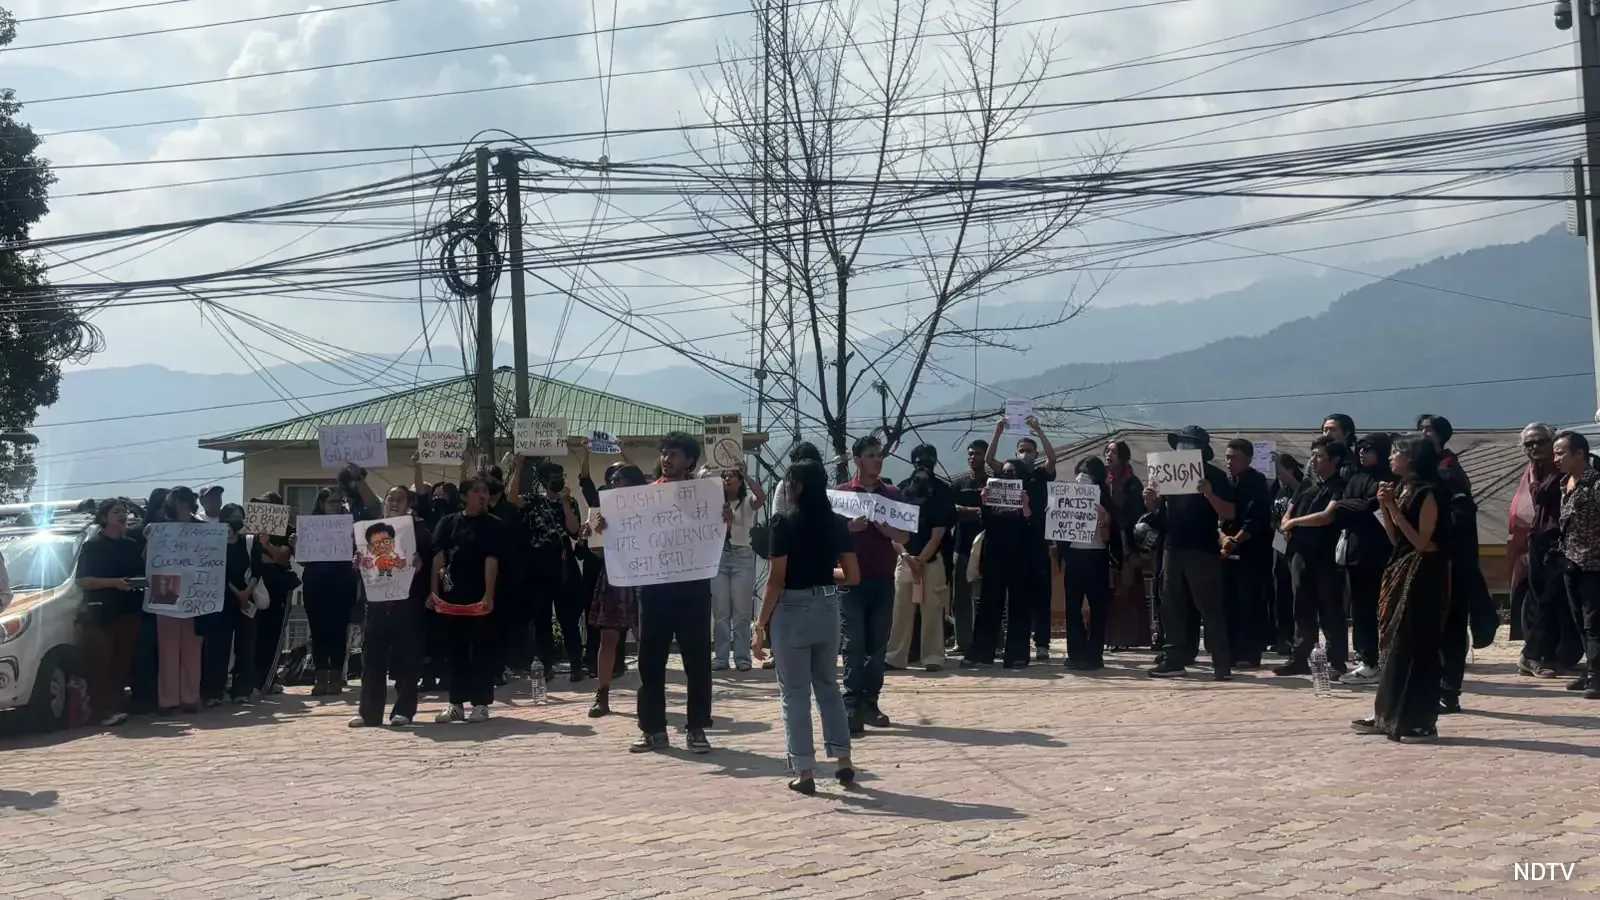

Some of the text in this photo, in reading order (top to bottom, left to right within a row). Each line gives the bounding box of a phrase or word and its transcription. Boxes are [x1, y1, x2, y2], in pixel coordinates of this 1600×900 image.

[516, 421, 527, 430] NO
[517, 430, 528, 439] NO
[593, 430, 609, 441] NO
[424, 440, 465, 450] GO BACK
[515, 438, 569, 449] EVEN FOR PM
[324, 448, 342, 463] GO
[421, 449, 435, 459] GO
[1050, 485, 1096, 497] KEEP YOUR
[616, 490, 665, 511] DUSHT
[1058, 497, 1096, 509] FACIST
[874, 502, 886, 515] GO
[890, 507, 917, 523] BACK
[260, 513, 287, 529] BACK
[1058, 521, 1087, 530] OUT OF
[648, 523, 721, 549] GOVERNOR
[1052, 529, 1067, 540] MY
[185, 585, 220, 599] DONE
[183, 599, 217, 615] BRO
